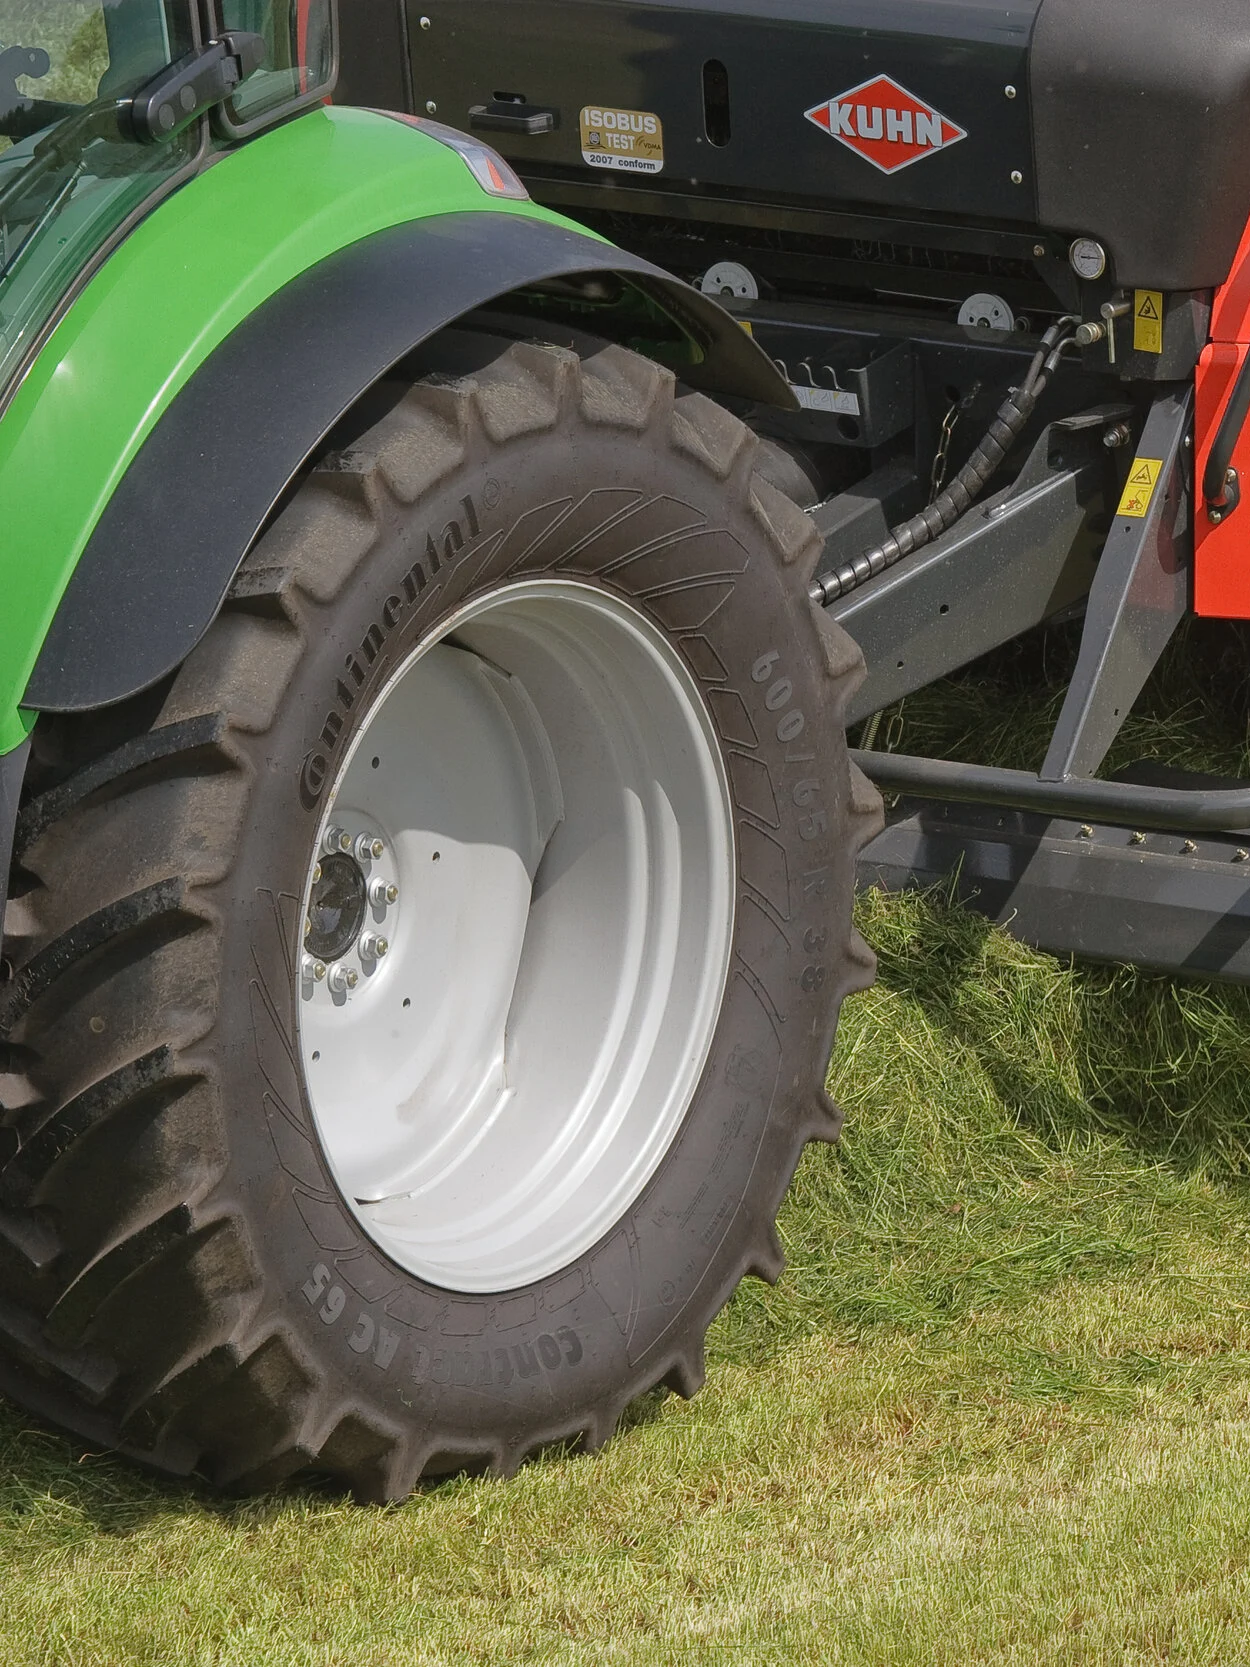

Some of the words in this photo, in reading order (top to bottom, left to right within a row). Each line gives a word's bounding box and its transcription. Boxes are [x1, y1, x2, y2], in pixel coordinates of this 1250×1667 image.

[584, 109, 657, 134] ISOBUS
[828, 101, 943, 147] KUHN
[605, 132, 635, 150] TEST
[590, 154, 613, 164] 2007
[618, 159, 656, 170] conform
[300, 1262, 347, 1326] 65
[347, 1311, 401, 1371] AC
